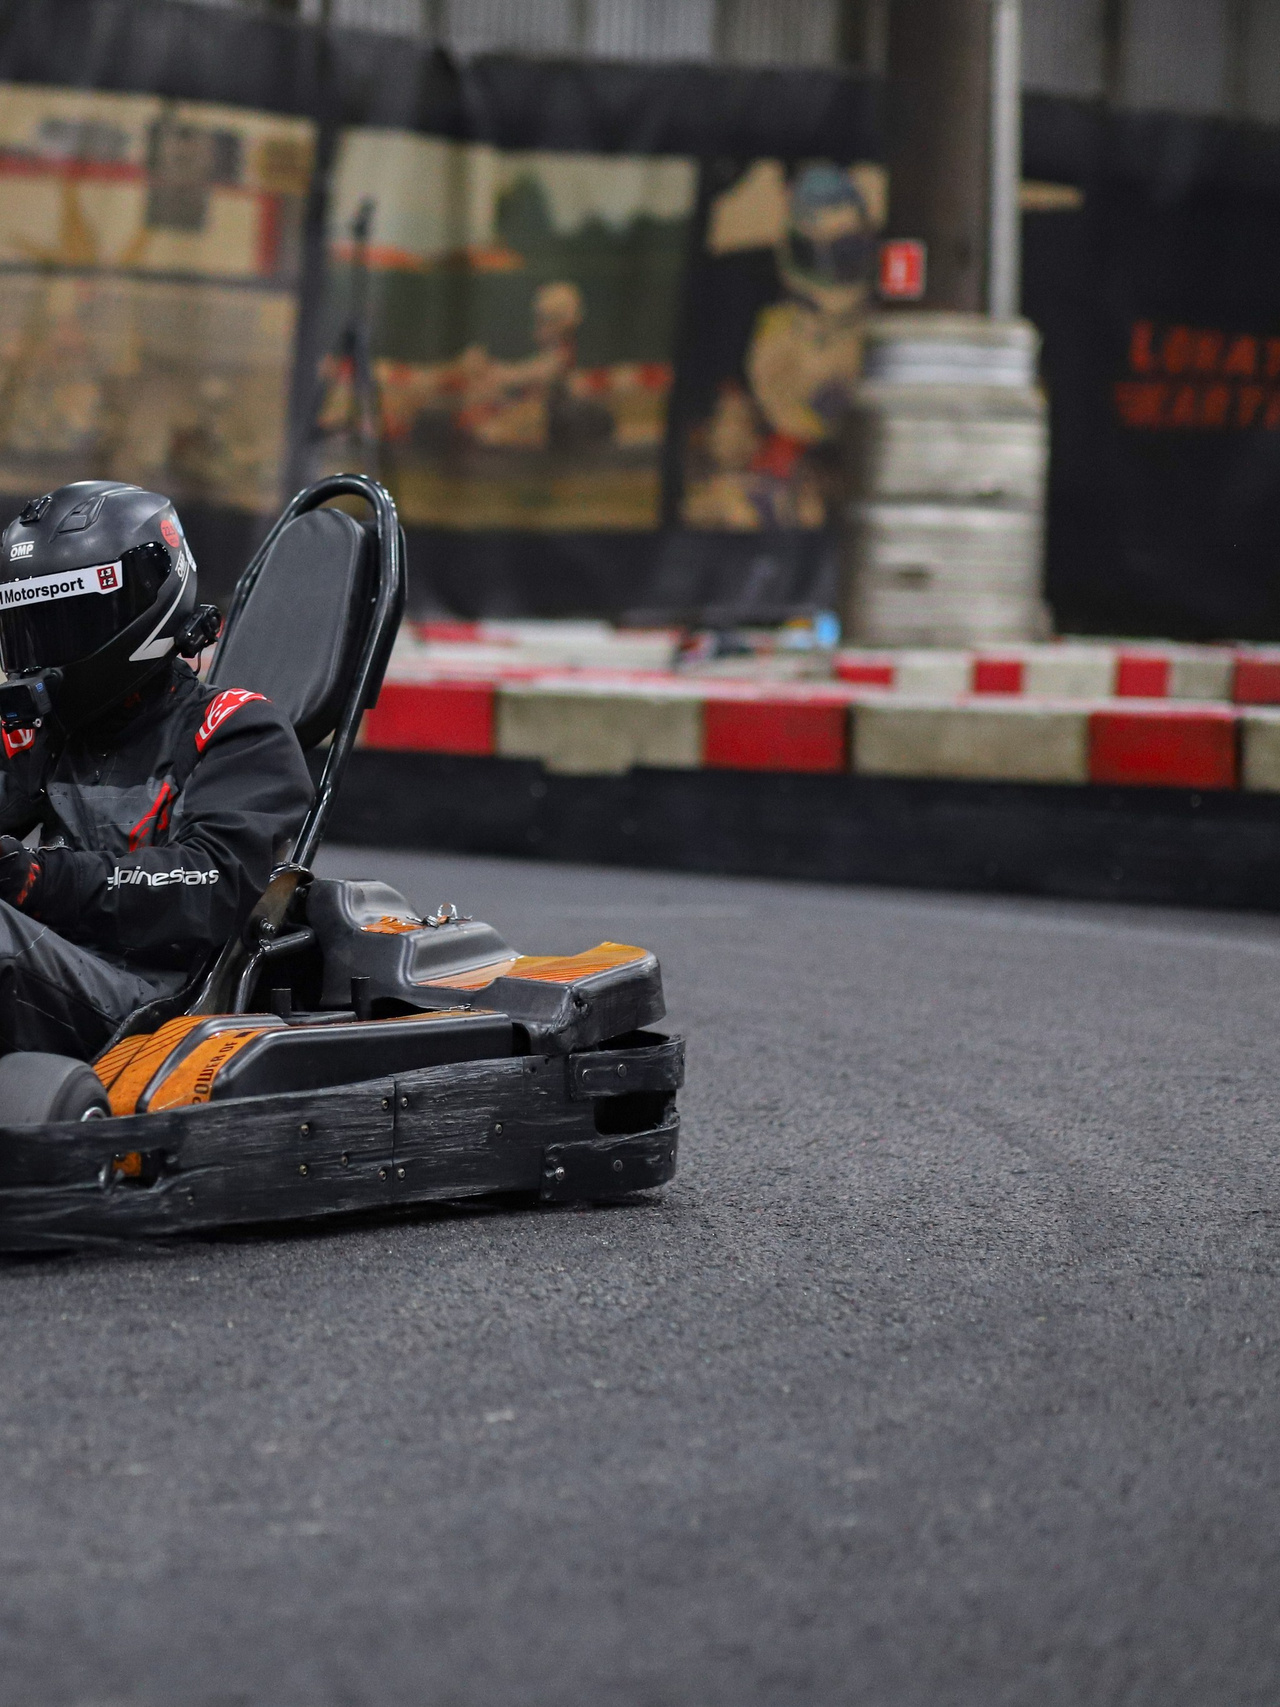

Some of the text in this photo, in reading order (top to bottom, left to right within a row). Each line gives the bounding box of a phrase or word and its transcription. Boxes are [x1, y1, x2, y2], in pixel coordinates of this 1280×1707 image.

[10, 544, 34, 558] OMP
[102, 577, 114, 587] 12
[4, 577, 85, 604] Motorsport
